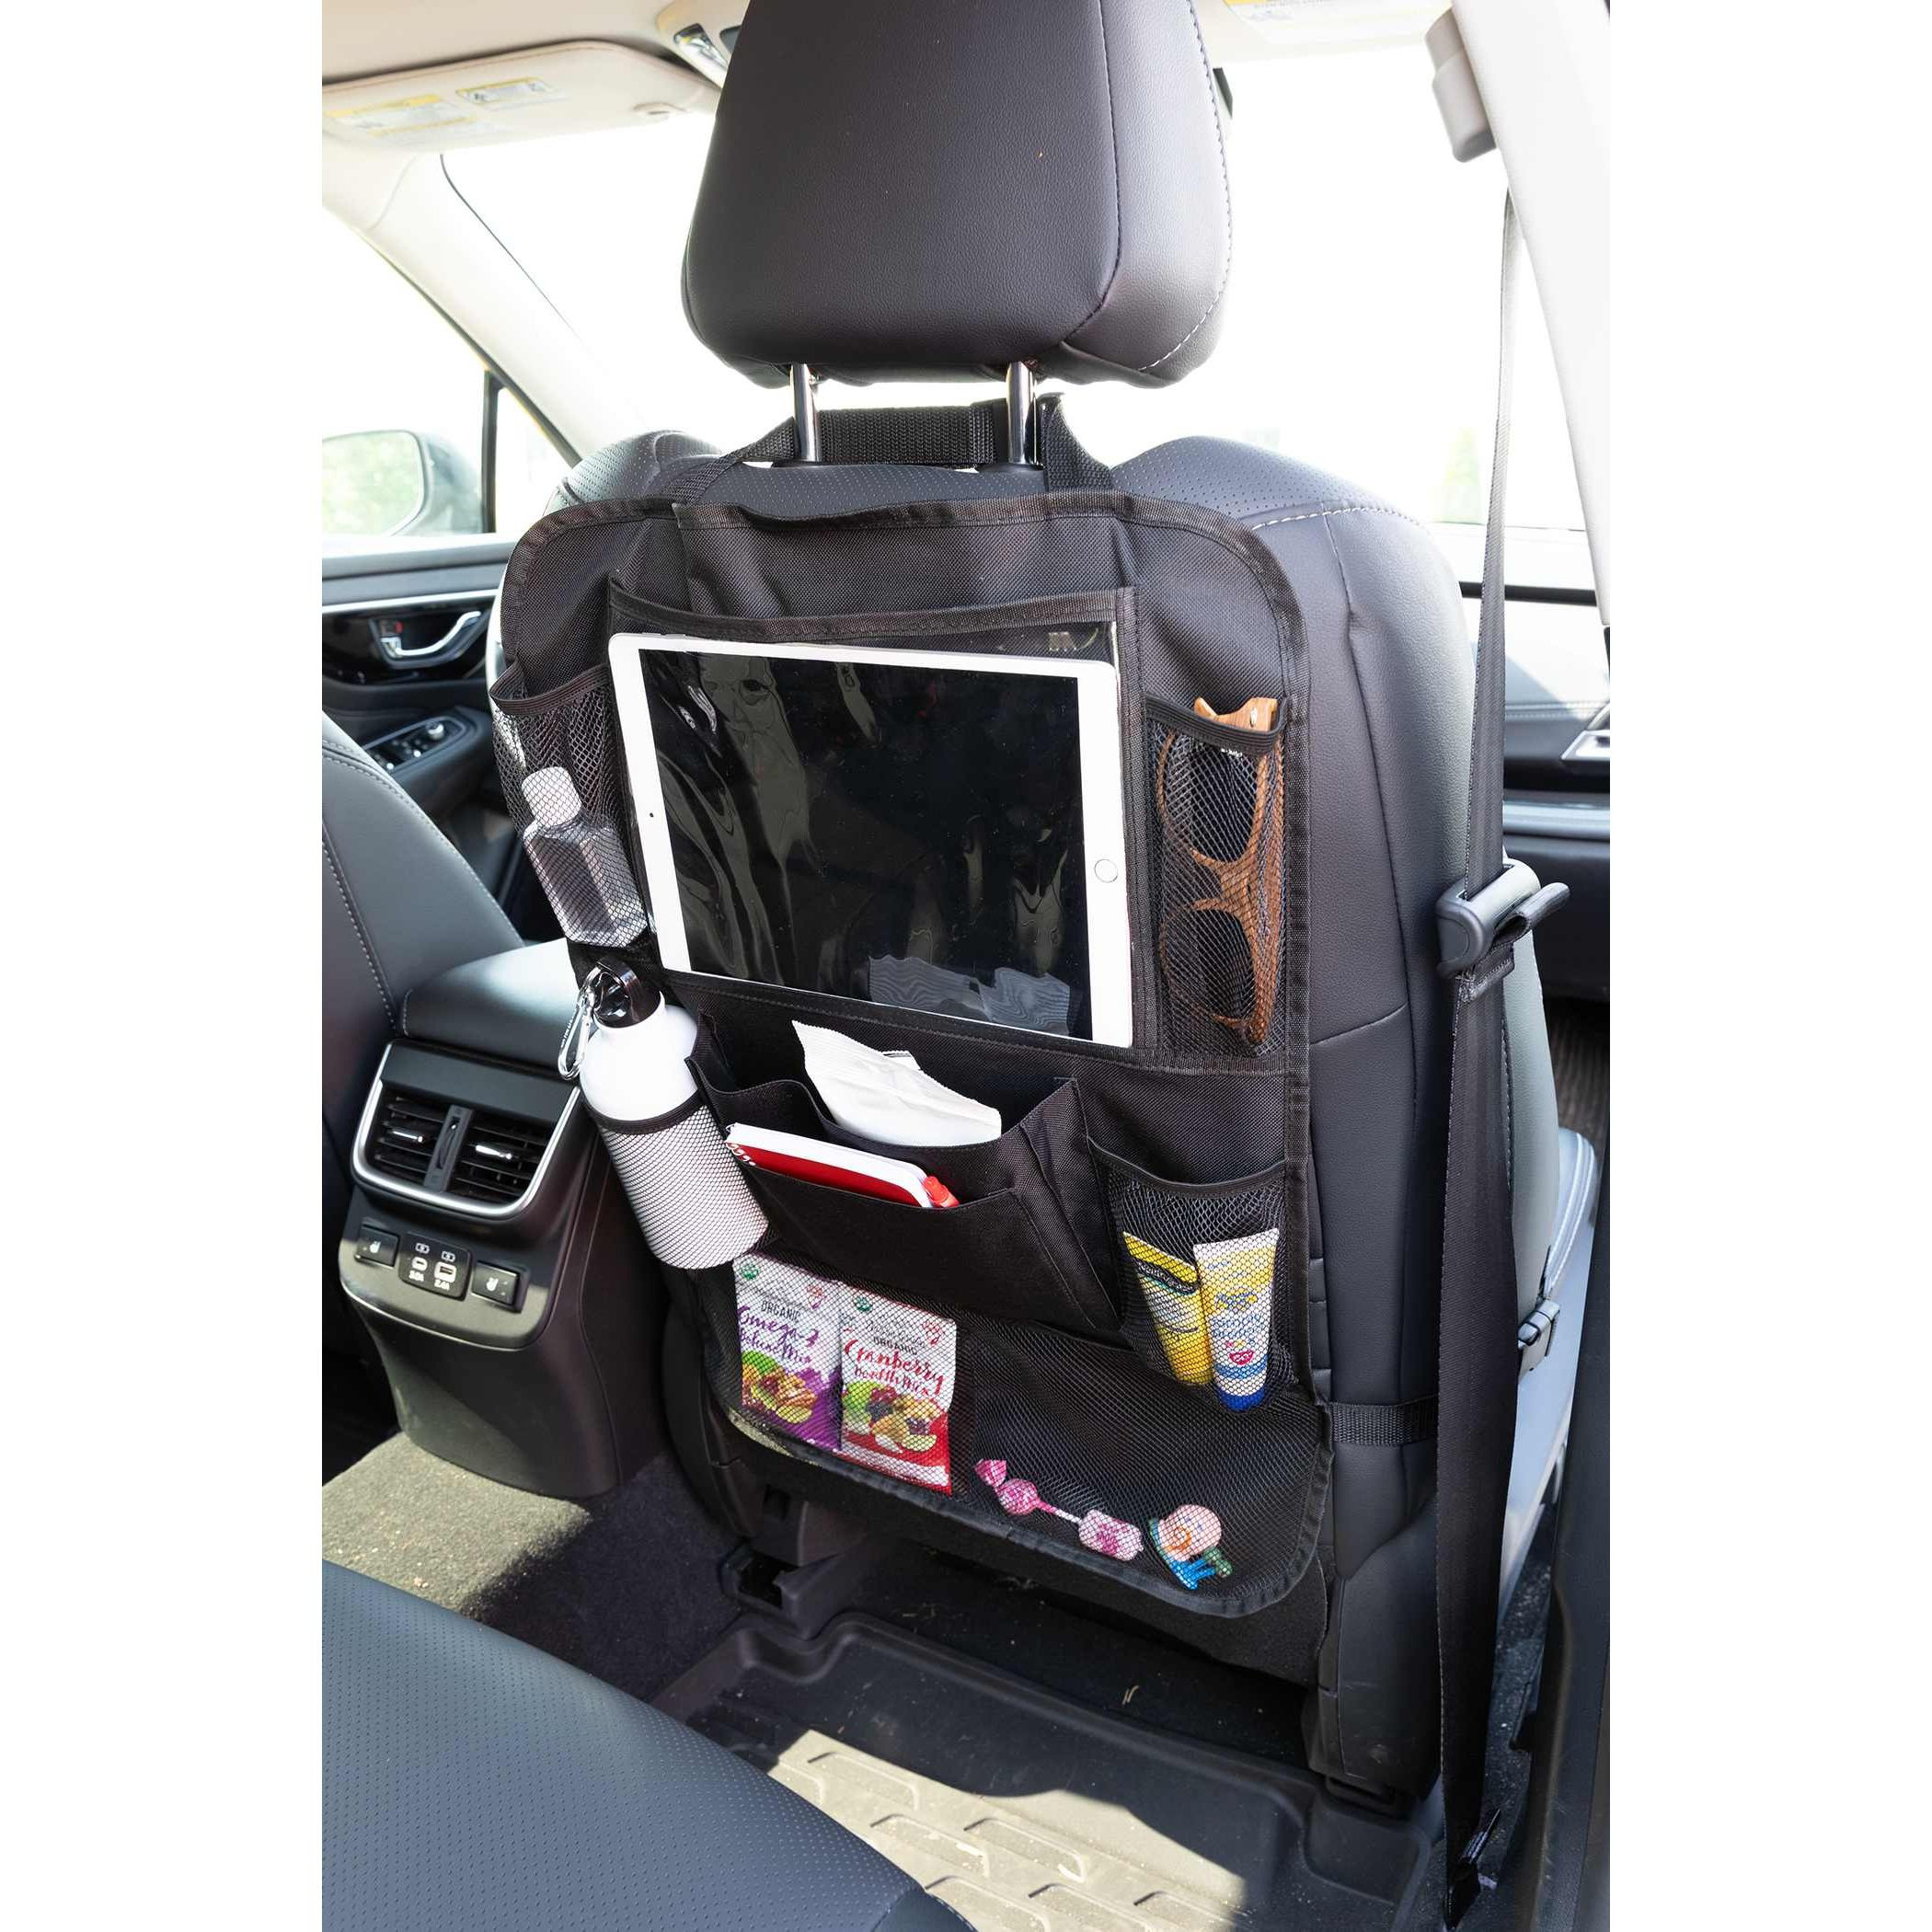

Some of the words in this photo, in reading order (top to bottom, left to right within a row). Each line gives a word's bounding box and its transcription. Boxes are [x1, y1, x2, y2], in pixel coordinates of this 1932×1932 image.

[737, 1305, 819, 1347] Omega-3
[761, 1300, 800, 1324] ORGANIC
[873, 1337, 917, 1355] ORGANIC
[844, 1339, 944, 1396] Cranberry
